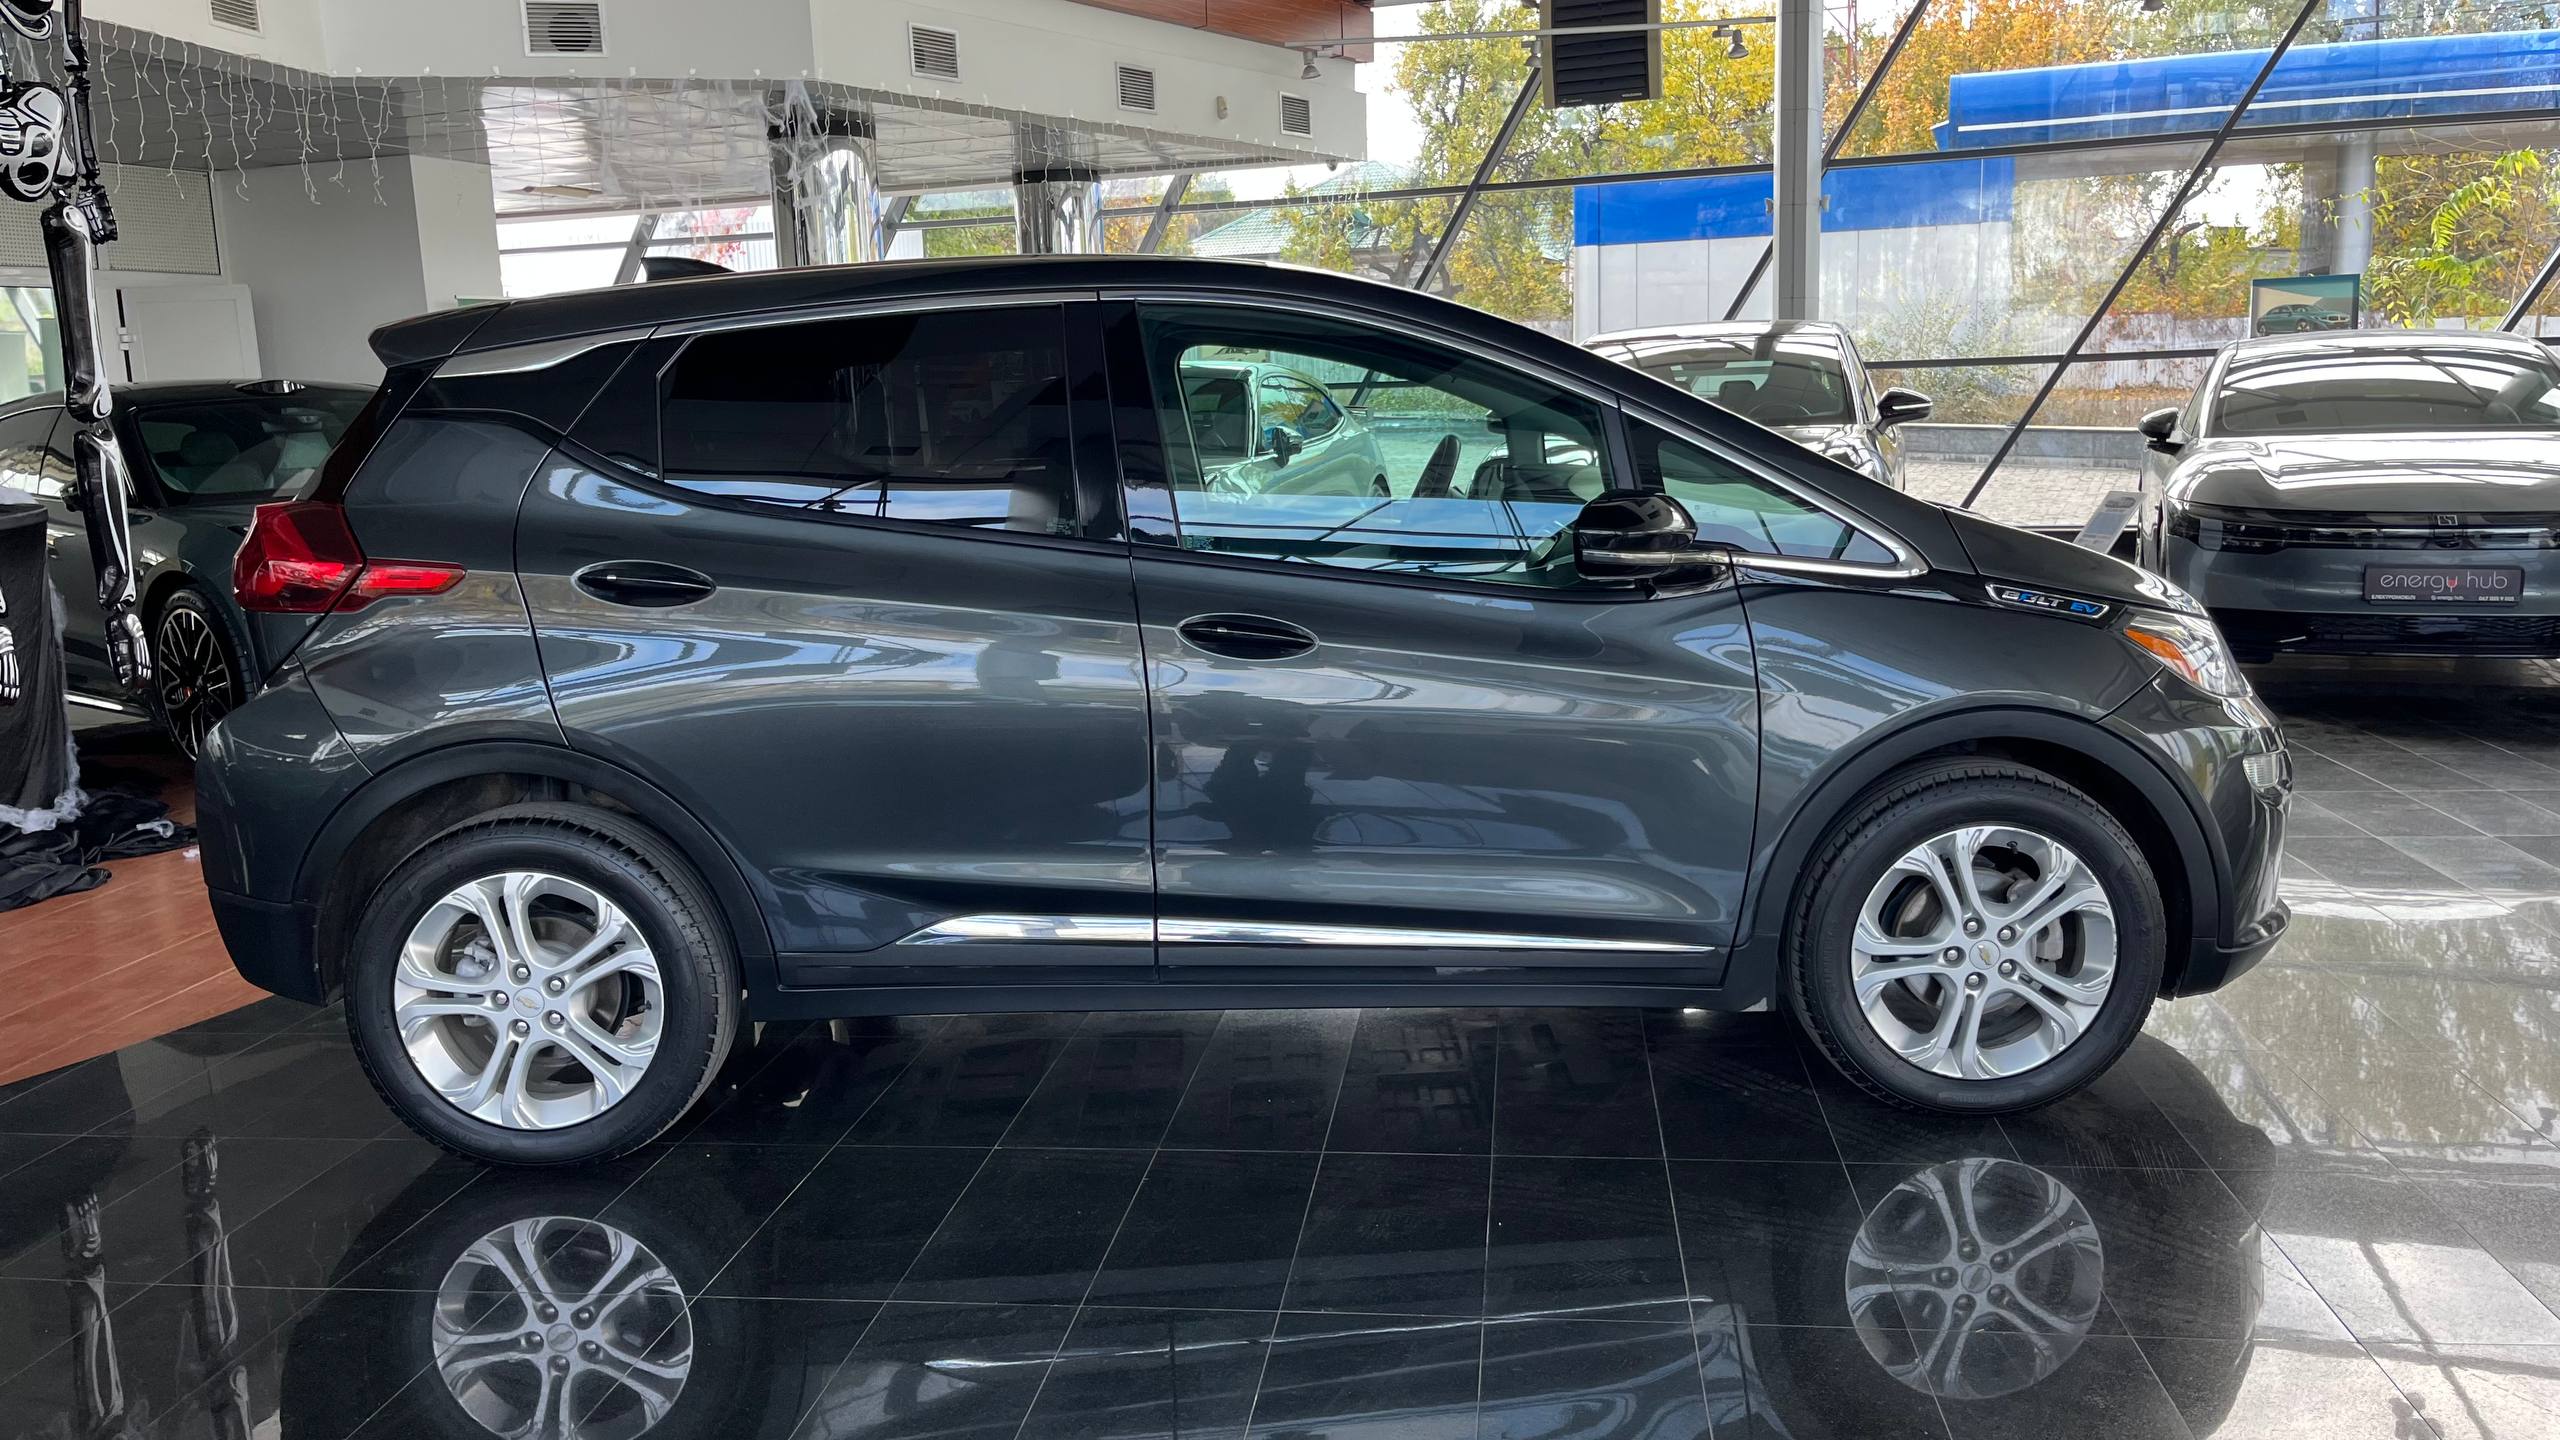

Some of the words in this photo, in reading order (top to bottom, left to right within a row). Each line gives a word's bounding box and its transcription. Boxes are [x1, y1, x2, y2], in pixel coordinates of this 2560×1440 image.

[2380, 574, 2458, 593] energy
[2466, 571, 2508, 589] hub
[2070, 601, 2100, 613] EV
